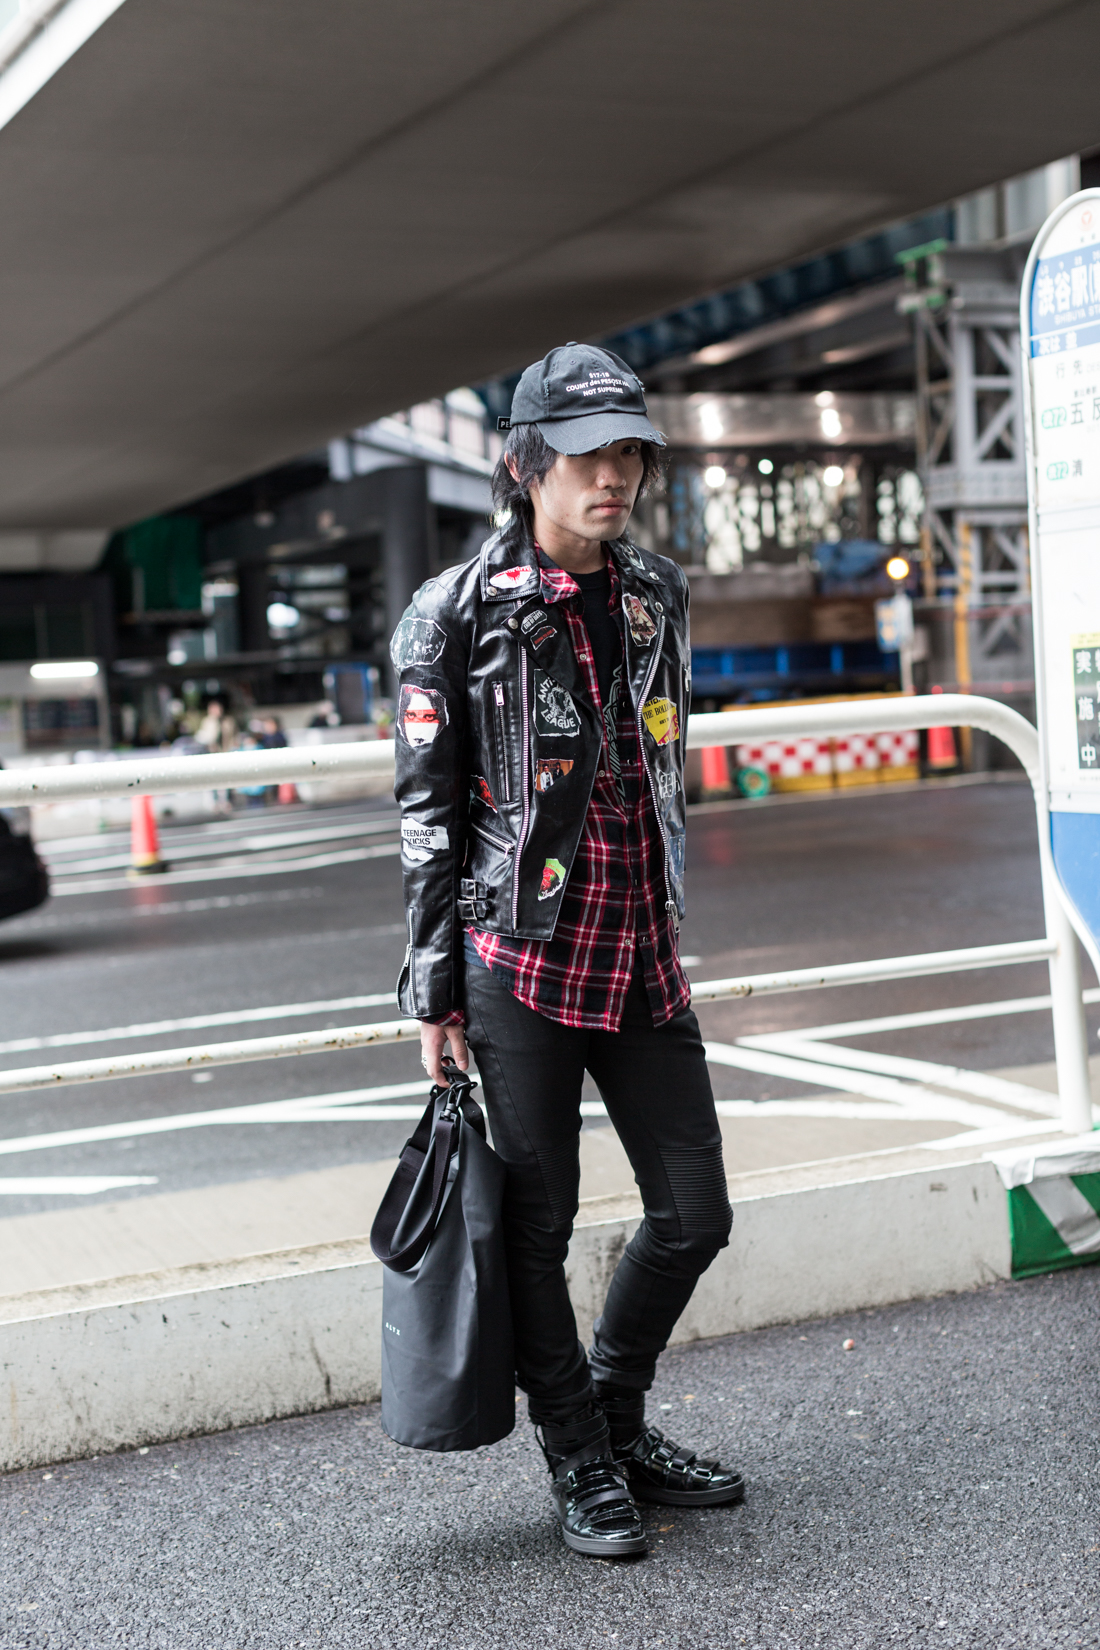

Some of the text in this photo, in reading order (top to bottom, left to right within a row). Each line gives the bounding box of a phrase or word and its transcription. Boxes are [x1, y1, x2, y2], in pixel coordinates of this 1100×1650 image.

[1054, 308, 1086, 326] SHIBUYA
[583, 388, 596, 396] NOT
[540, 708, 576, 729] LEAGUE
[643, 710, 654, 720] THE
[403, 829, 437, 837] TEENAGE
